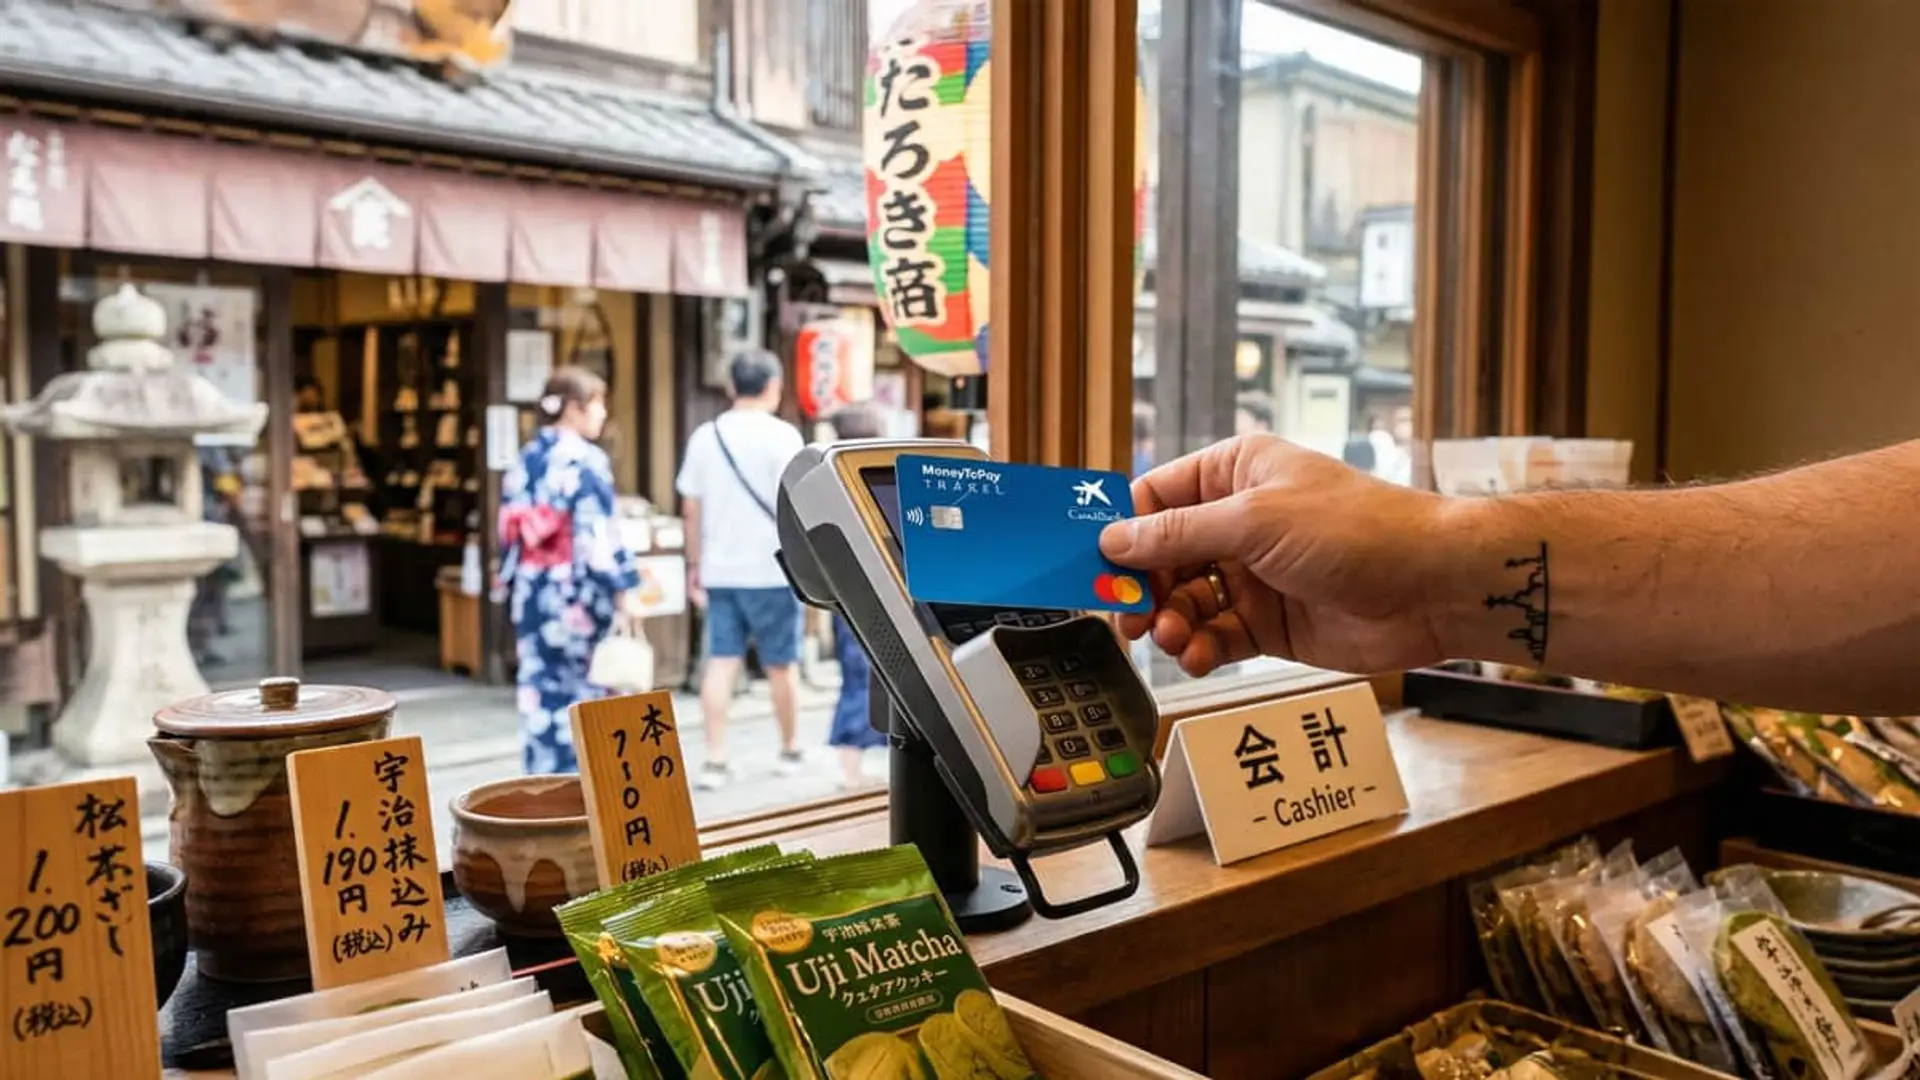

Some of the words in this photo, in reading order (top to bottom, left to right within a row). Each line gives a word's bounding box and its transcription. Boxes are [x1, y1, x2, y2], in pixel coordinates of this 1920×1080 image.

[922, 465, 1001, 484] MoneyToPay
[1234, 706, 1348, 790] 会計
[1273, 784, 1357, 826] Cashier
[786, 952, 849, 999] Uji
[845, 928, 963, 979] Matcha
[693, 969, 752, 1015] Uji
